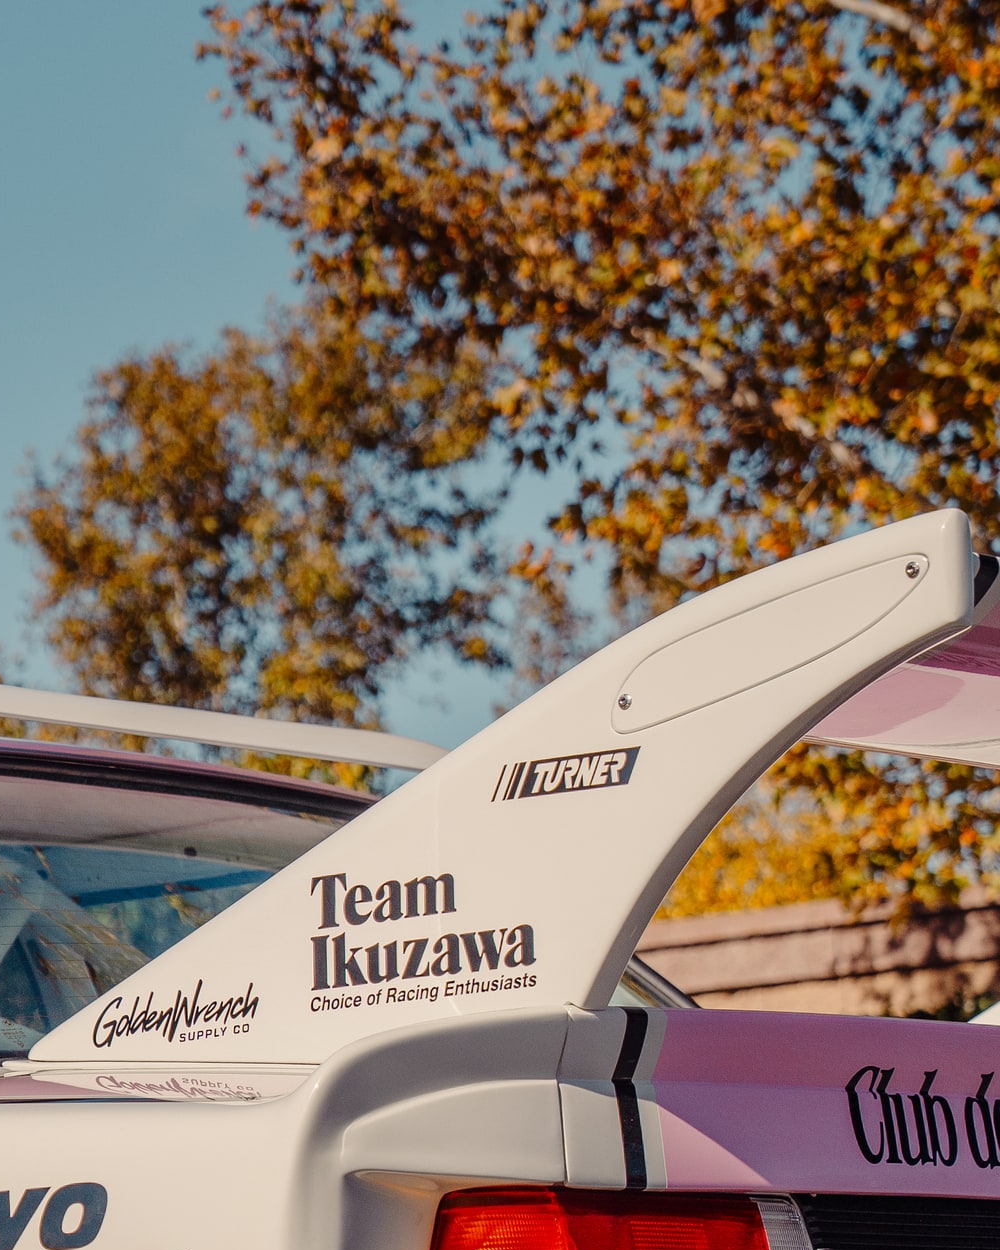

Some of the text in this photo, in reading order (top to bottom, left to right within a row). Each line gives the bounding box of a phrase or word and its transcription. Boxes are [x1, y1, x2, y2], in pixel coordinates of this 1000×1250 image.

[531, 751, 628, 794] TURNER
[310, 873, 457, 930] Team
[310, 923, 537, 991] Ikuzawa
[310, 973, 537, 1012] Choice of Racing Enthusiasts
[179, 1023, 251, 1043] SUPPLY CO
[845, 1066, 958, 1167] Club
